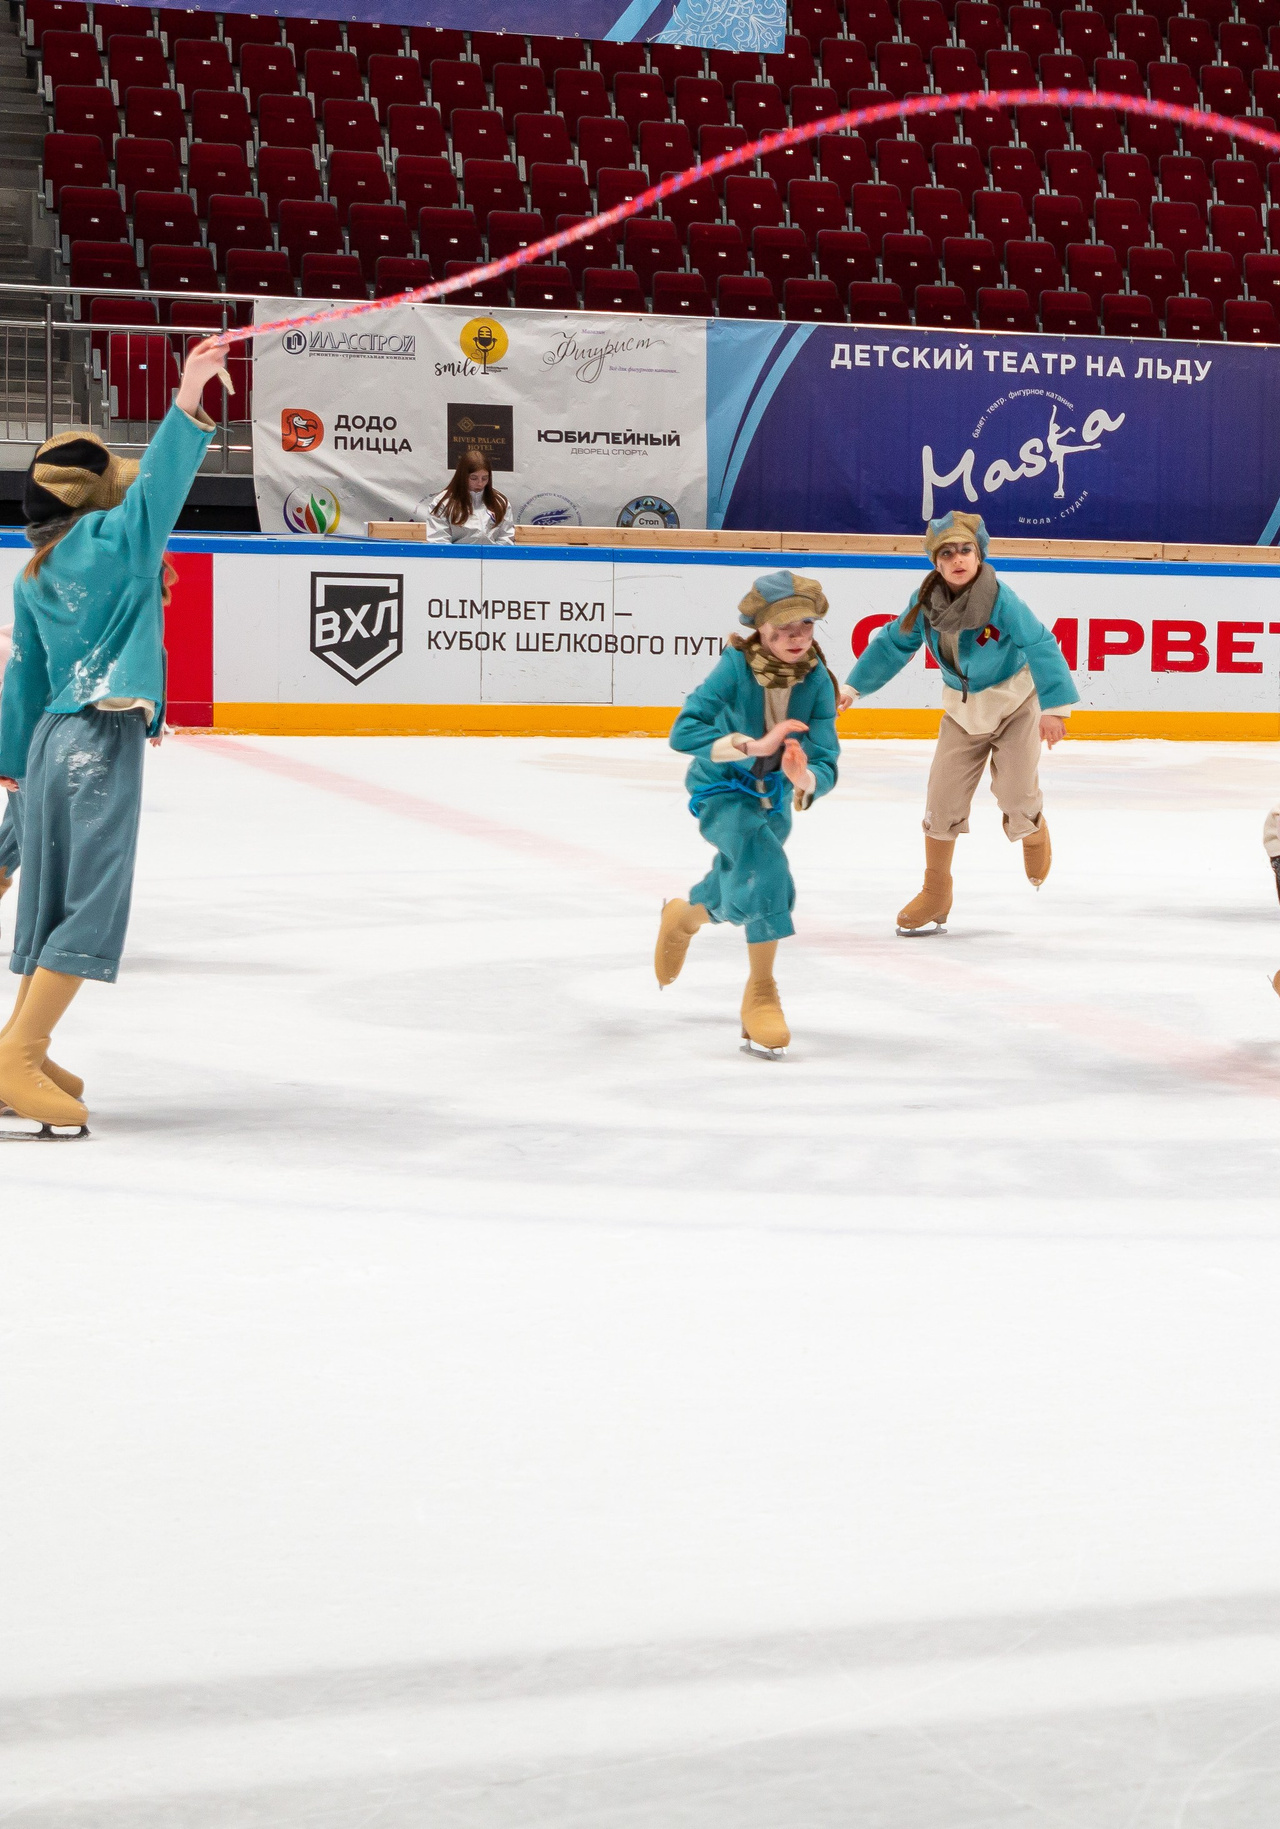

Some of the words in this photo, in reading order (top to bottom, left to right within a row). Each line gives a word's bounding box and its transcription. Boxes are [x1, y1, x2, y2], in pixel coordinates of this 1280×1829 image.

[434, 357, 480, 377] smile
[540, 331, 666, 383] Фигурист
[830, 344, 974, 370] ДЕТСКИЙ
[983, 350, 1077, 375] ТЕАТР
[1086, 356, 1126, 378] НА
[1134, 358, 1212, 385] ЛЬДУ
[1008, 388, 1044, 400] фигурное
[334, 414, 397, 433] ДОДО
[334, 436, 412, 455] ПИЦЦА
[537, 429, 681, 447] ЮБИЛЕЙНЫЙ
[570, 448, 610, 456] ДВОРЕЦ
[1018, 516, 1051, 525] школа
[1060, 490, 1088, 518] студия
[638, 517, 660, 526] Стоп
[428, 598, 550, 620] OLIMPBET
[560, 601, 605, 622] ВХЛ
[315, 598, 399, 648] ВХЛ
[427, 630, 506, 651] КУБОК
[516, 632, 664, 655] ШЕЛКОВОГО
